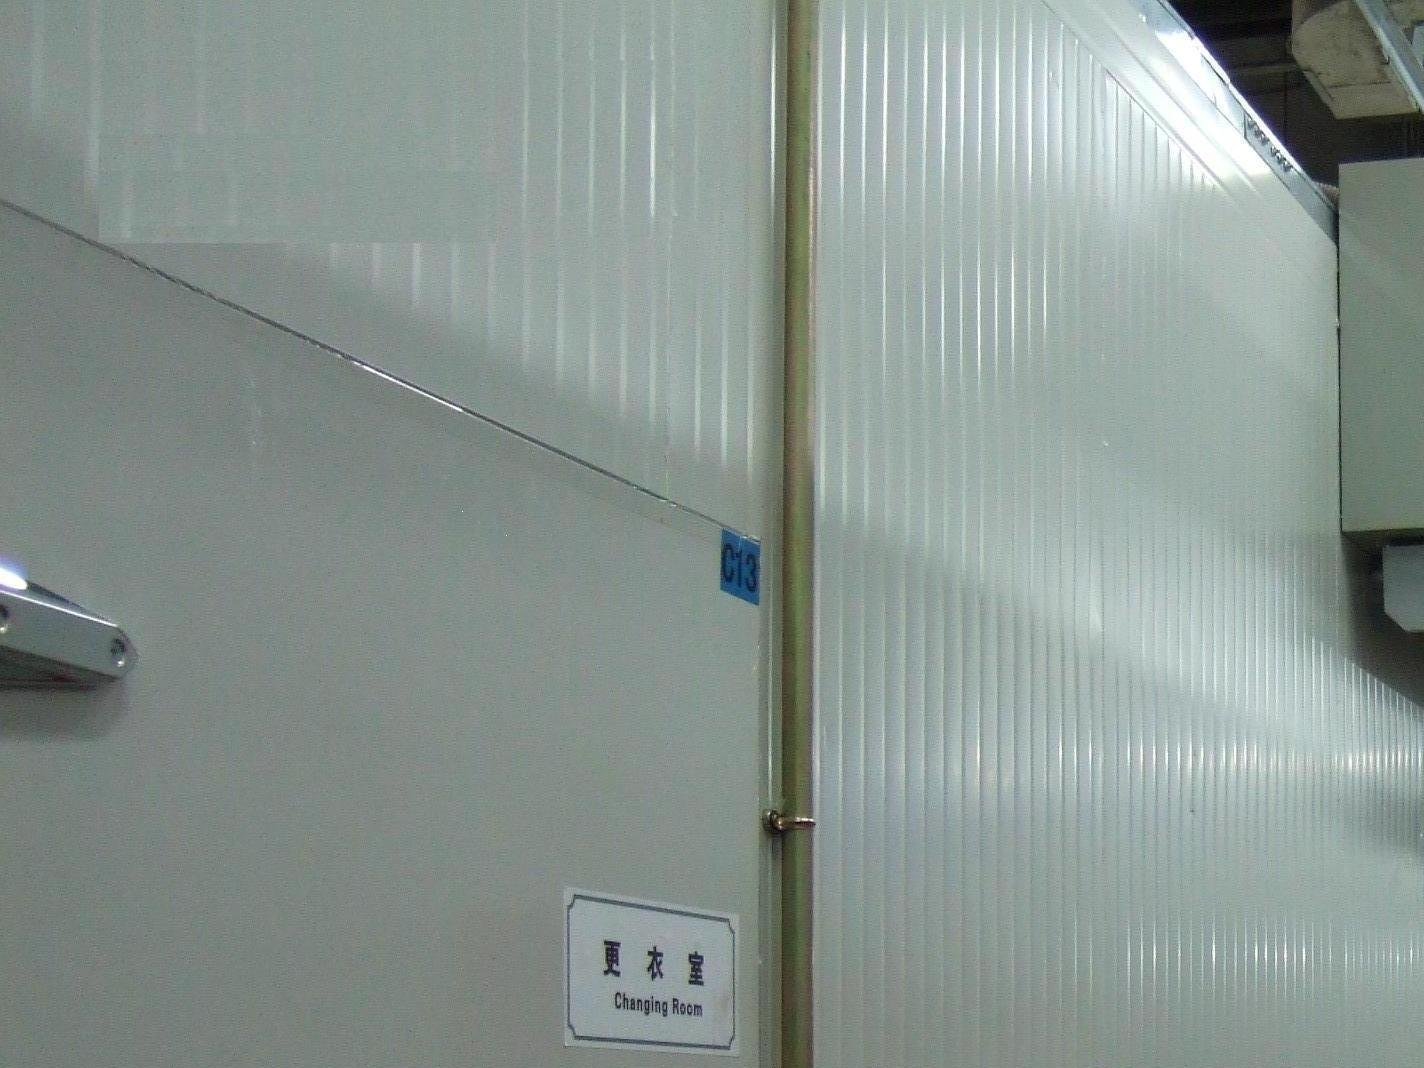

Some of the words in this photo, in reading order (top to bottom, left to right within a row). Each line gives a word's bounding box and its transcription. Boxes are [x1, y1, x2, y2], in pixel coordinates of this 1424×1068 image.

[721, 544, 759, 593] C13
[603, 940, 704, 986] 更衣室
[615, 992, 668, 1017] Changing
[672, 998, 703, 1017] Room
